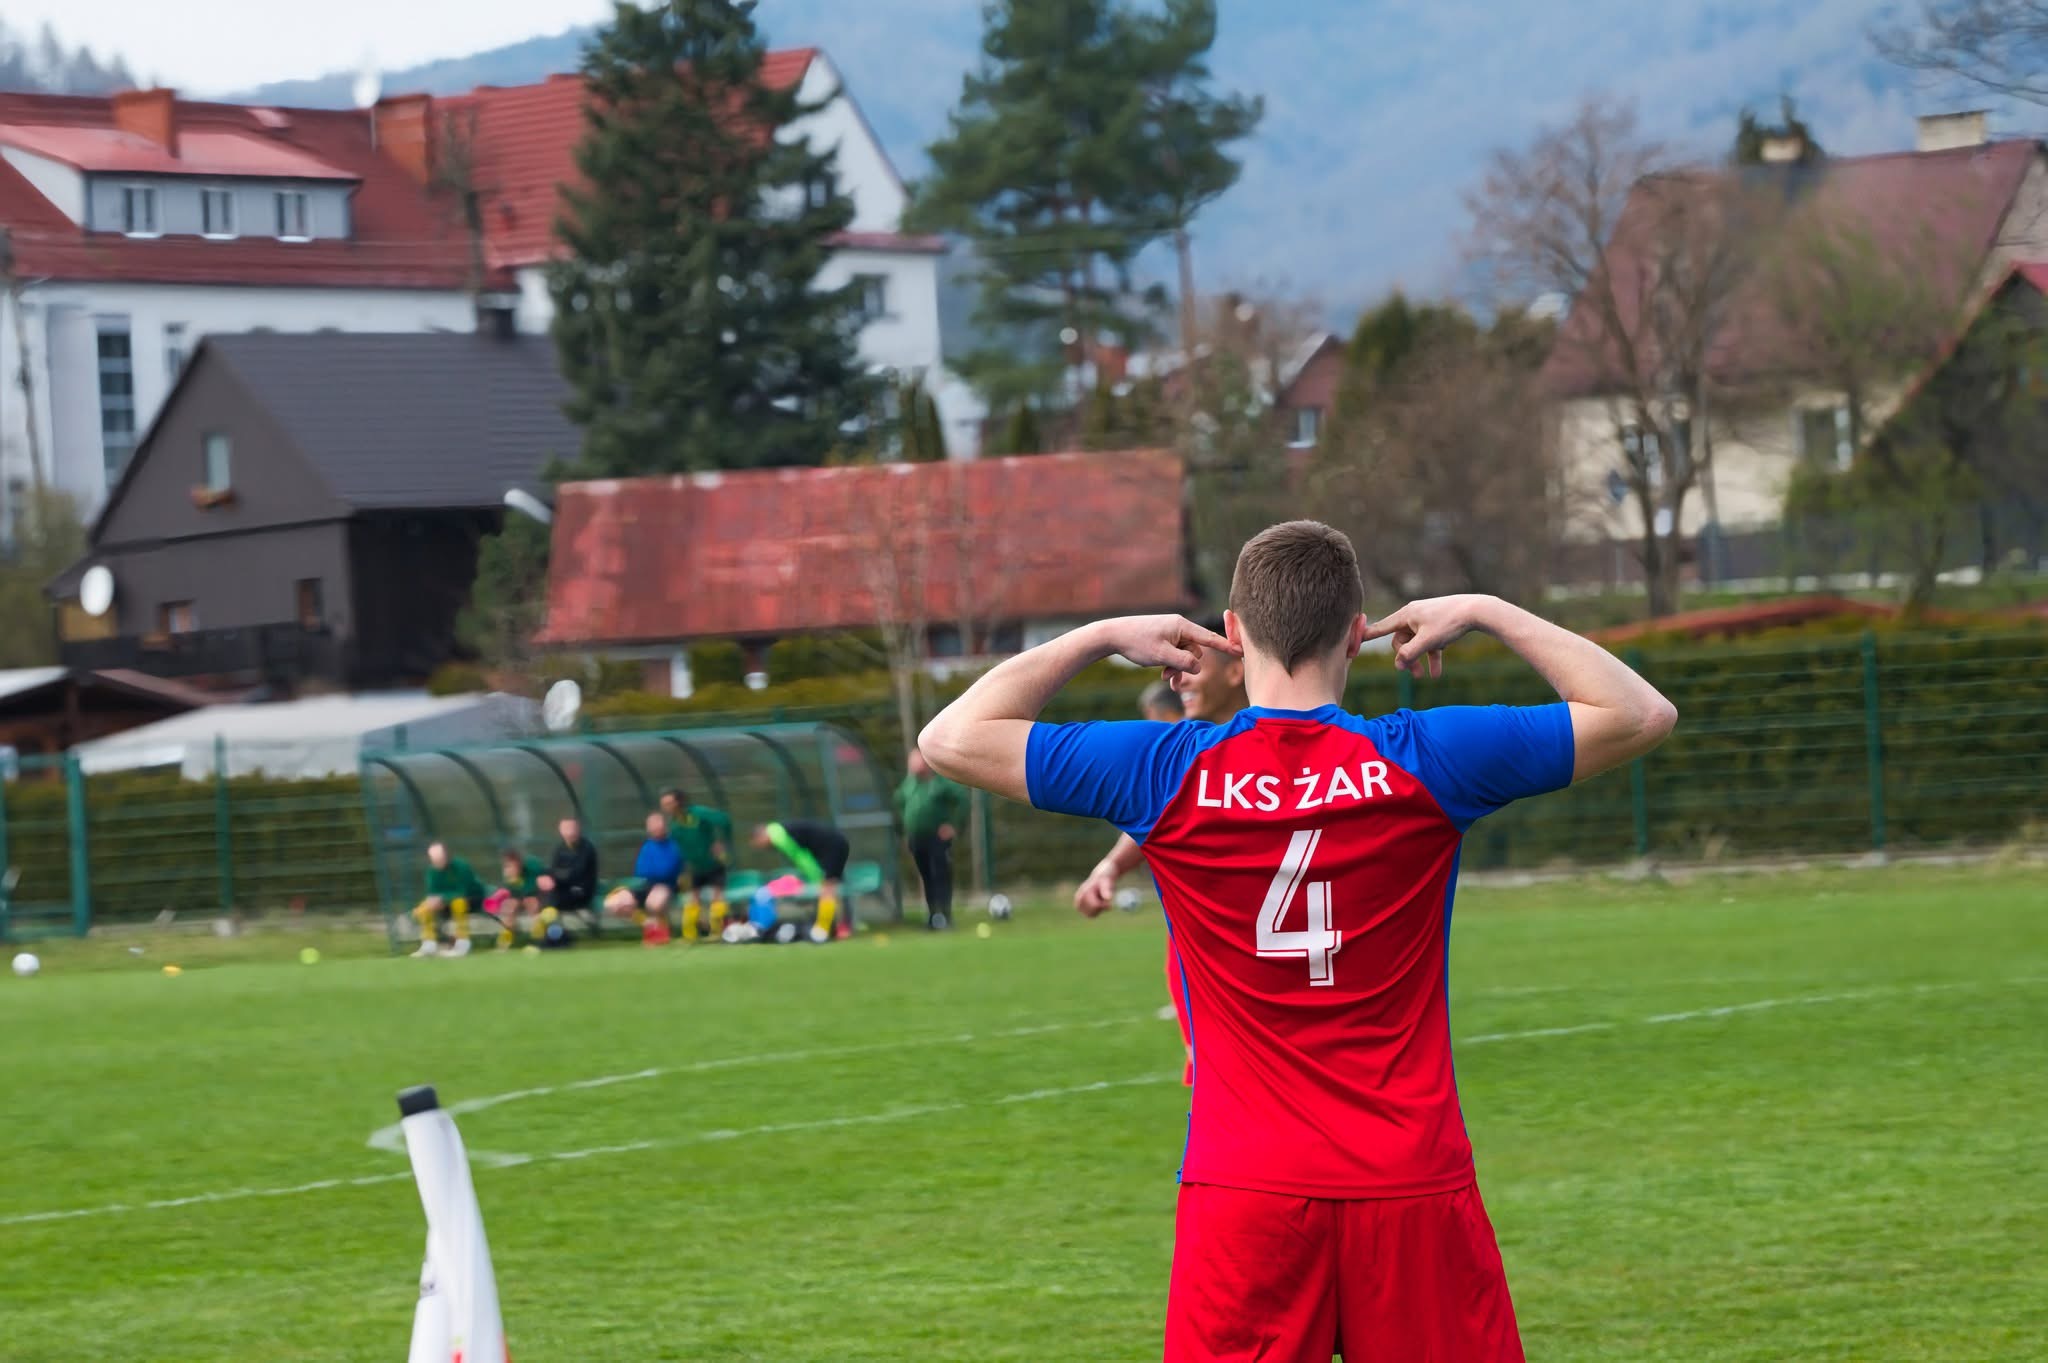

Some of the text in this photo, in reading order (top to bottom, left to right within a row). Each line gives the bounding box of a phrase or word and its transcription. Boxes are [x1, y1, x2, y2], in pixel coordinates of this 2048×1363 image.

[1197, 760, 1393, 812] LKS ŻAR
[1255, 828, 1342, 987] 4
